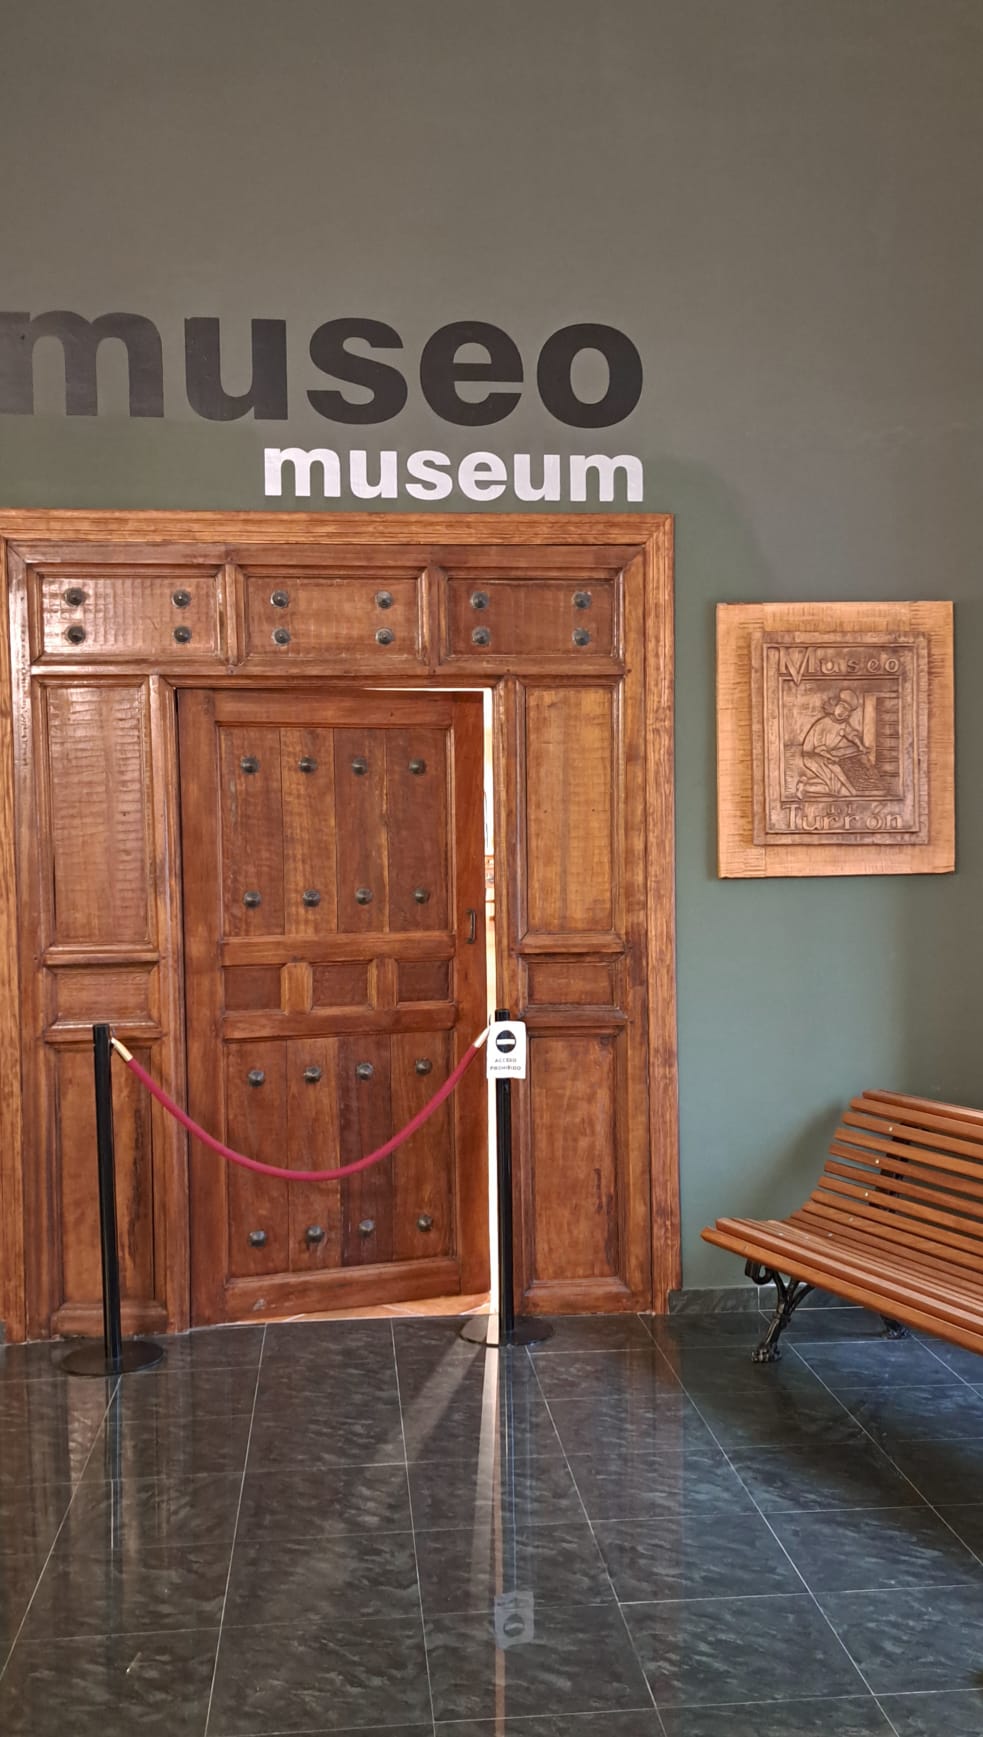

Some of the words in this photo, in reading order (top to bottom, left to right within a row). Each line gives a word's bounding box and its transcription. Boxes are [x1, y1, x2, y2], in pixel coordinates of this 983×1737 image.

[0, 310, 643, 428] museo
[264, 446, 643, 503] museum
[778, 646, 901, 686] Museo
[782, 803, 904, 831] Turrón
